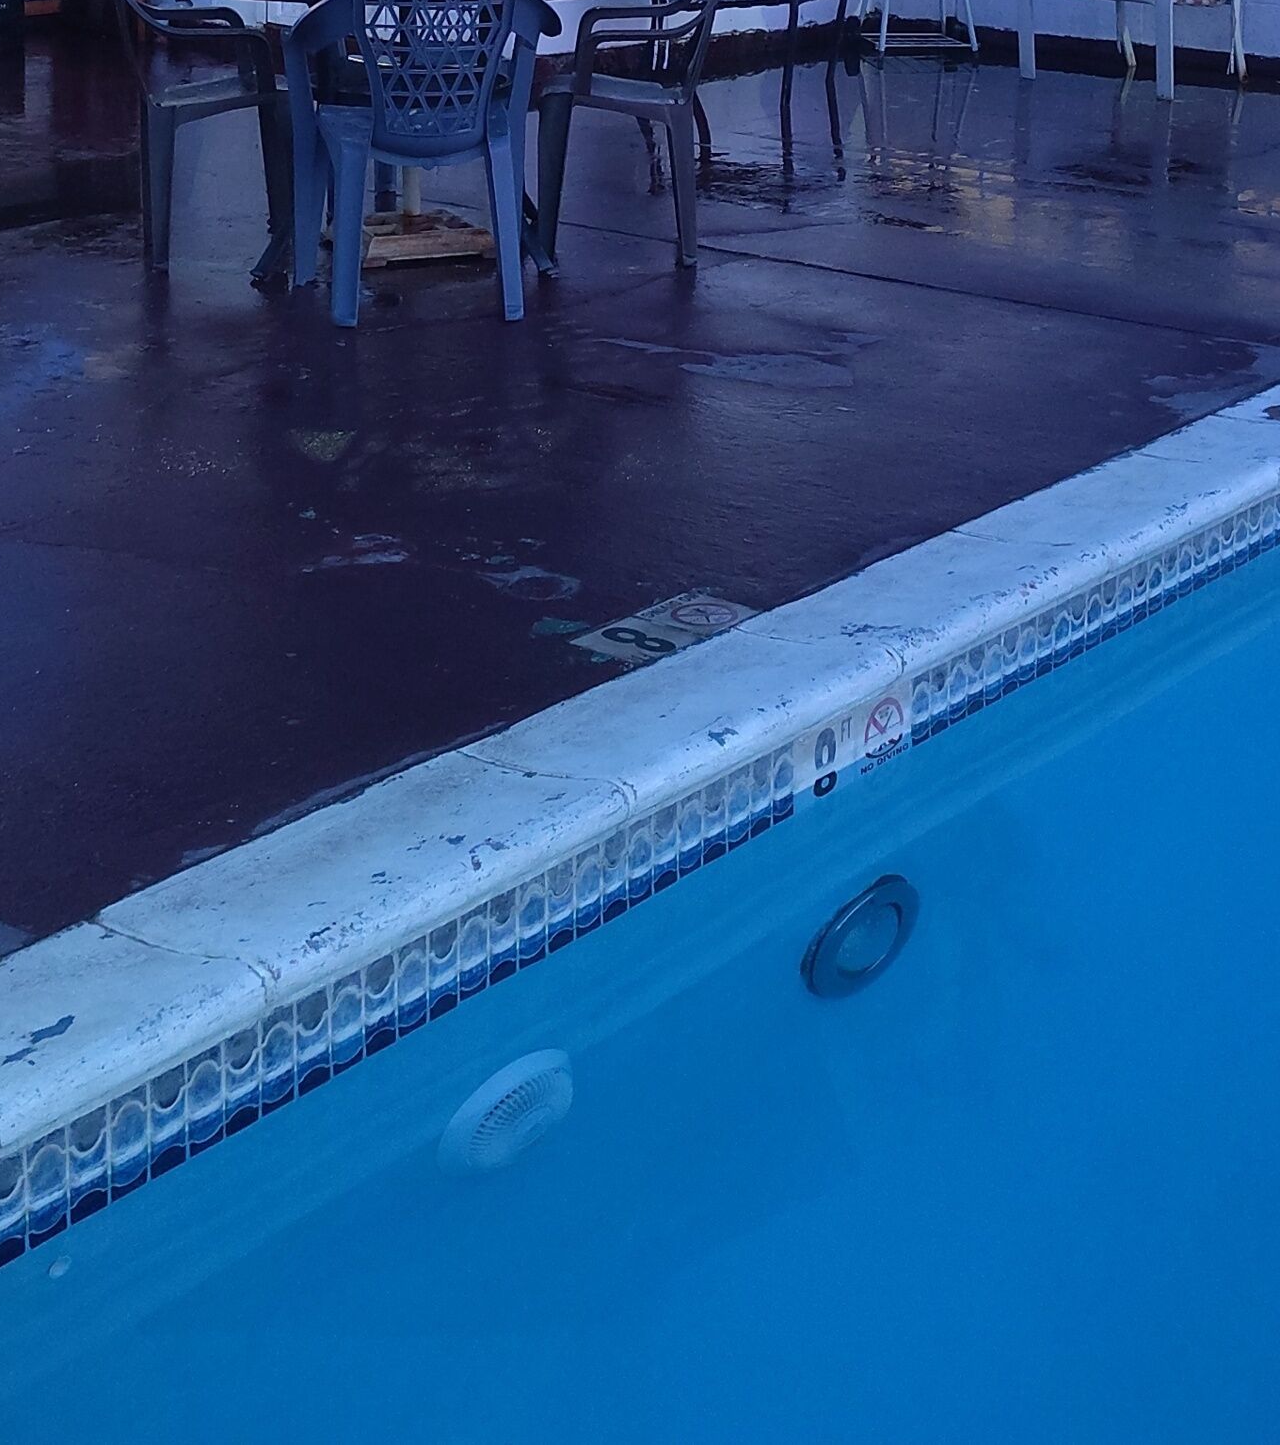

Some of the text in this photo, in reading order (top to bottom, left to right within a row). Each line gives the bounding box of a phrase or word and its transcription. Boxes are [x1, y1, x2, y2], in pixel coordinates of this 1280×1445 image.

[601, 627, 676, 652] 8
[841, 716, 853, 742] FT
[860, 742, 909, 775] NO DIVING
